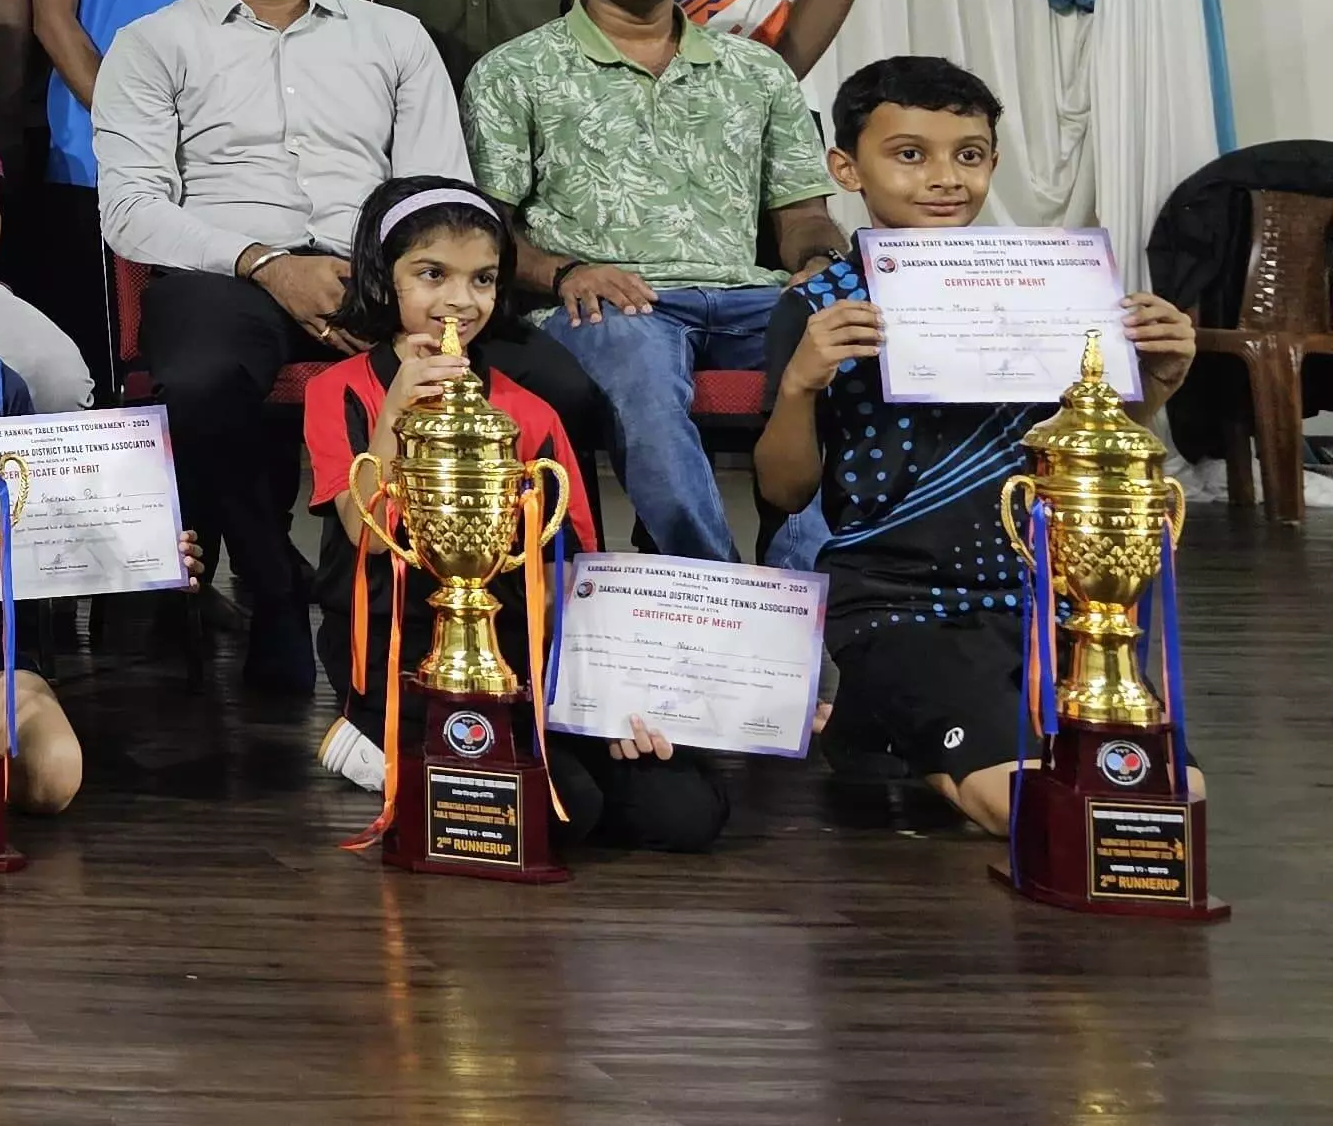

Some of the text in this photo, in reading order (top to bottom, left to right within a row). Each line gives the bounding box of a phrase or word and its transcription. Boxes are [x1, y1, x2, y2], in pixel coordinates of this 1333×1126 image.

[945, 278, 1045, 287] CERTIFICATE OF MERIT
[4, 464, 100, 480] CERFICATE OF MERIT
[599, 584, 632, 595] DAKSHINA
[669, 591, 704, 603] DISTRICT
[707, 596, 728, 606] TABLE
[731, 599, 756, 610] TENNIS
[759, 603, 809, 615] ASSOCIATION
[633, 609, 742, 629] CERTIFICATE OF MERIT
[454, 838, 512, 855] RUNNERUP
[1119, 876, 1180, 890] RUNNERUP
